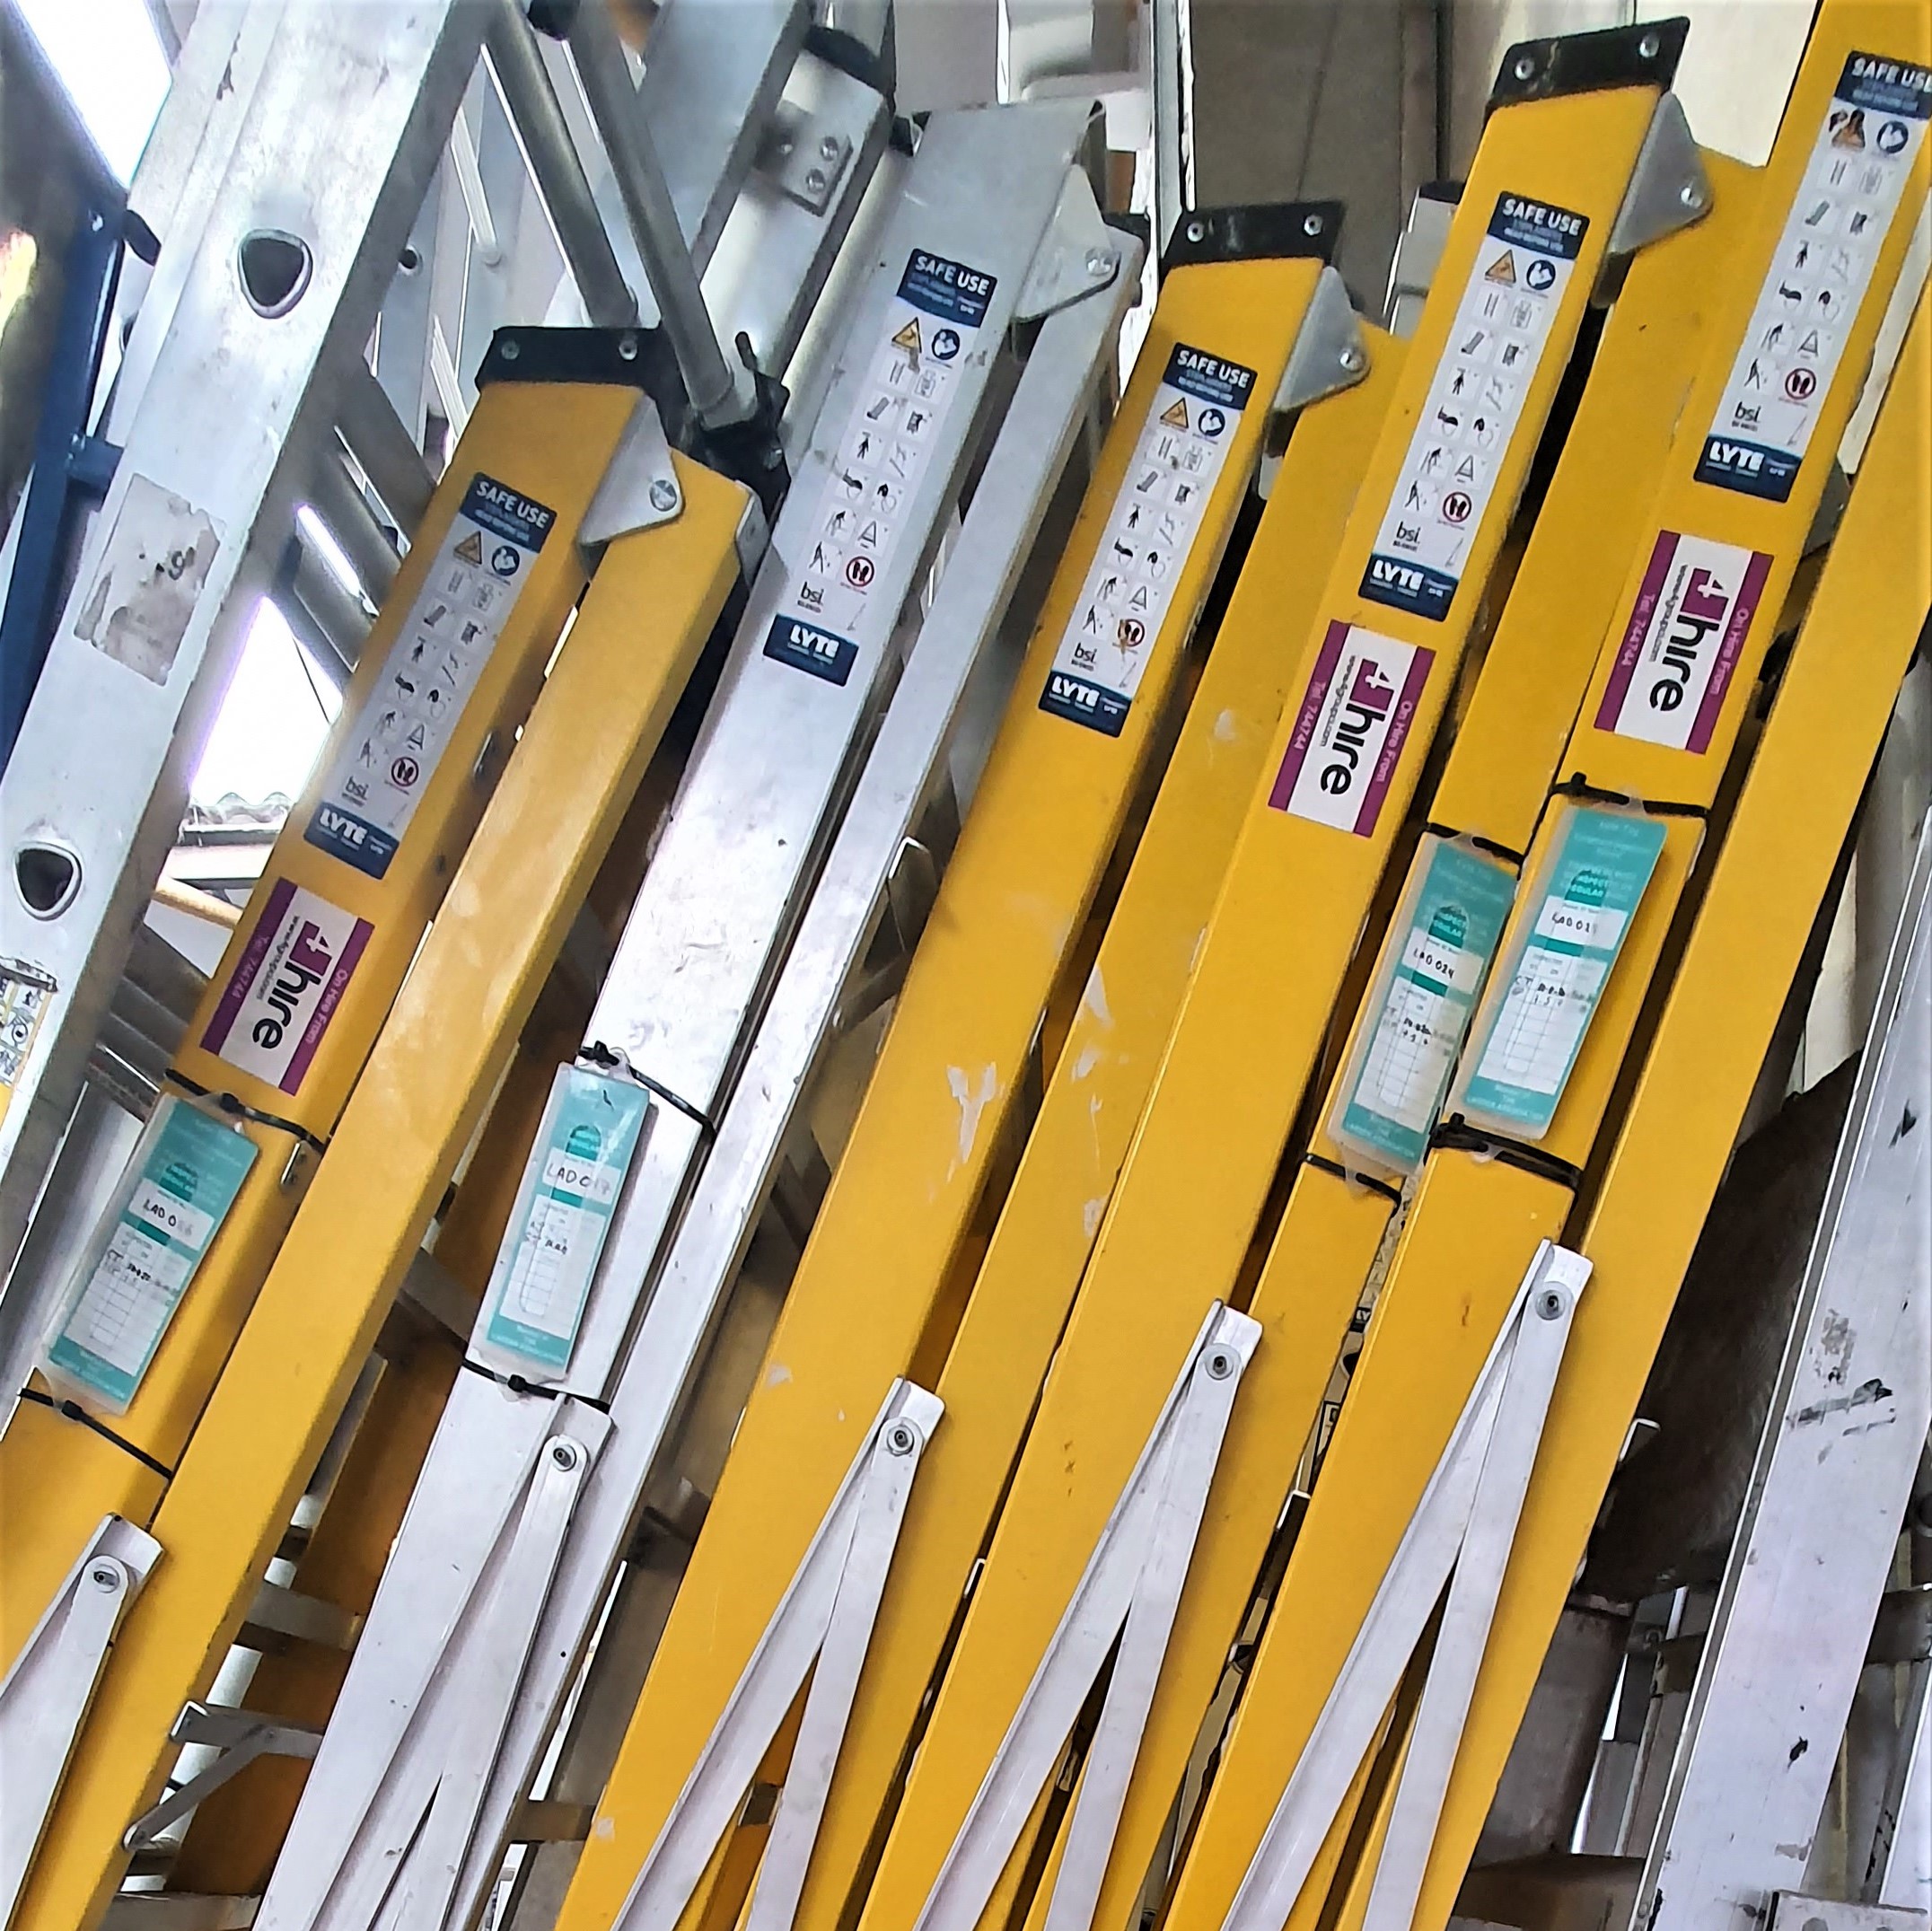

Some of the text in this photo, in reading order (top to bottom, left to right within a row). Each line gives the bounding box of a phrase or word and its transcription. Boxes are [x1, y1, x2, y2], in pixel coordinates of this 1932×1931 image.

[1852, 57, 1900, 83] SAFE
[1502, 198, 1547, 224] SAFE
[1548, 211, 1582, 236] USE
[915, 255, 957, 284] SAFE
[957, 270, 989, 296] USE
[1177, 349, 1218, 376] SAFE
[1218, 364, 1251, 389] USE
[1709, 441, 1765, 471] LYTE
[476, 480, 518, 512] SAFE
[516, 501, 549, 529] USE
[1372, 559, 1425, 591] LYTE
[790, 624, 839, 658] LYTE
[1051, 675, 1100, 707] LYTE
[1376, 700, 1413, 783] On Hire From
[320, 808, 367, 845] LYTE
